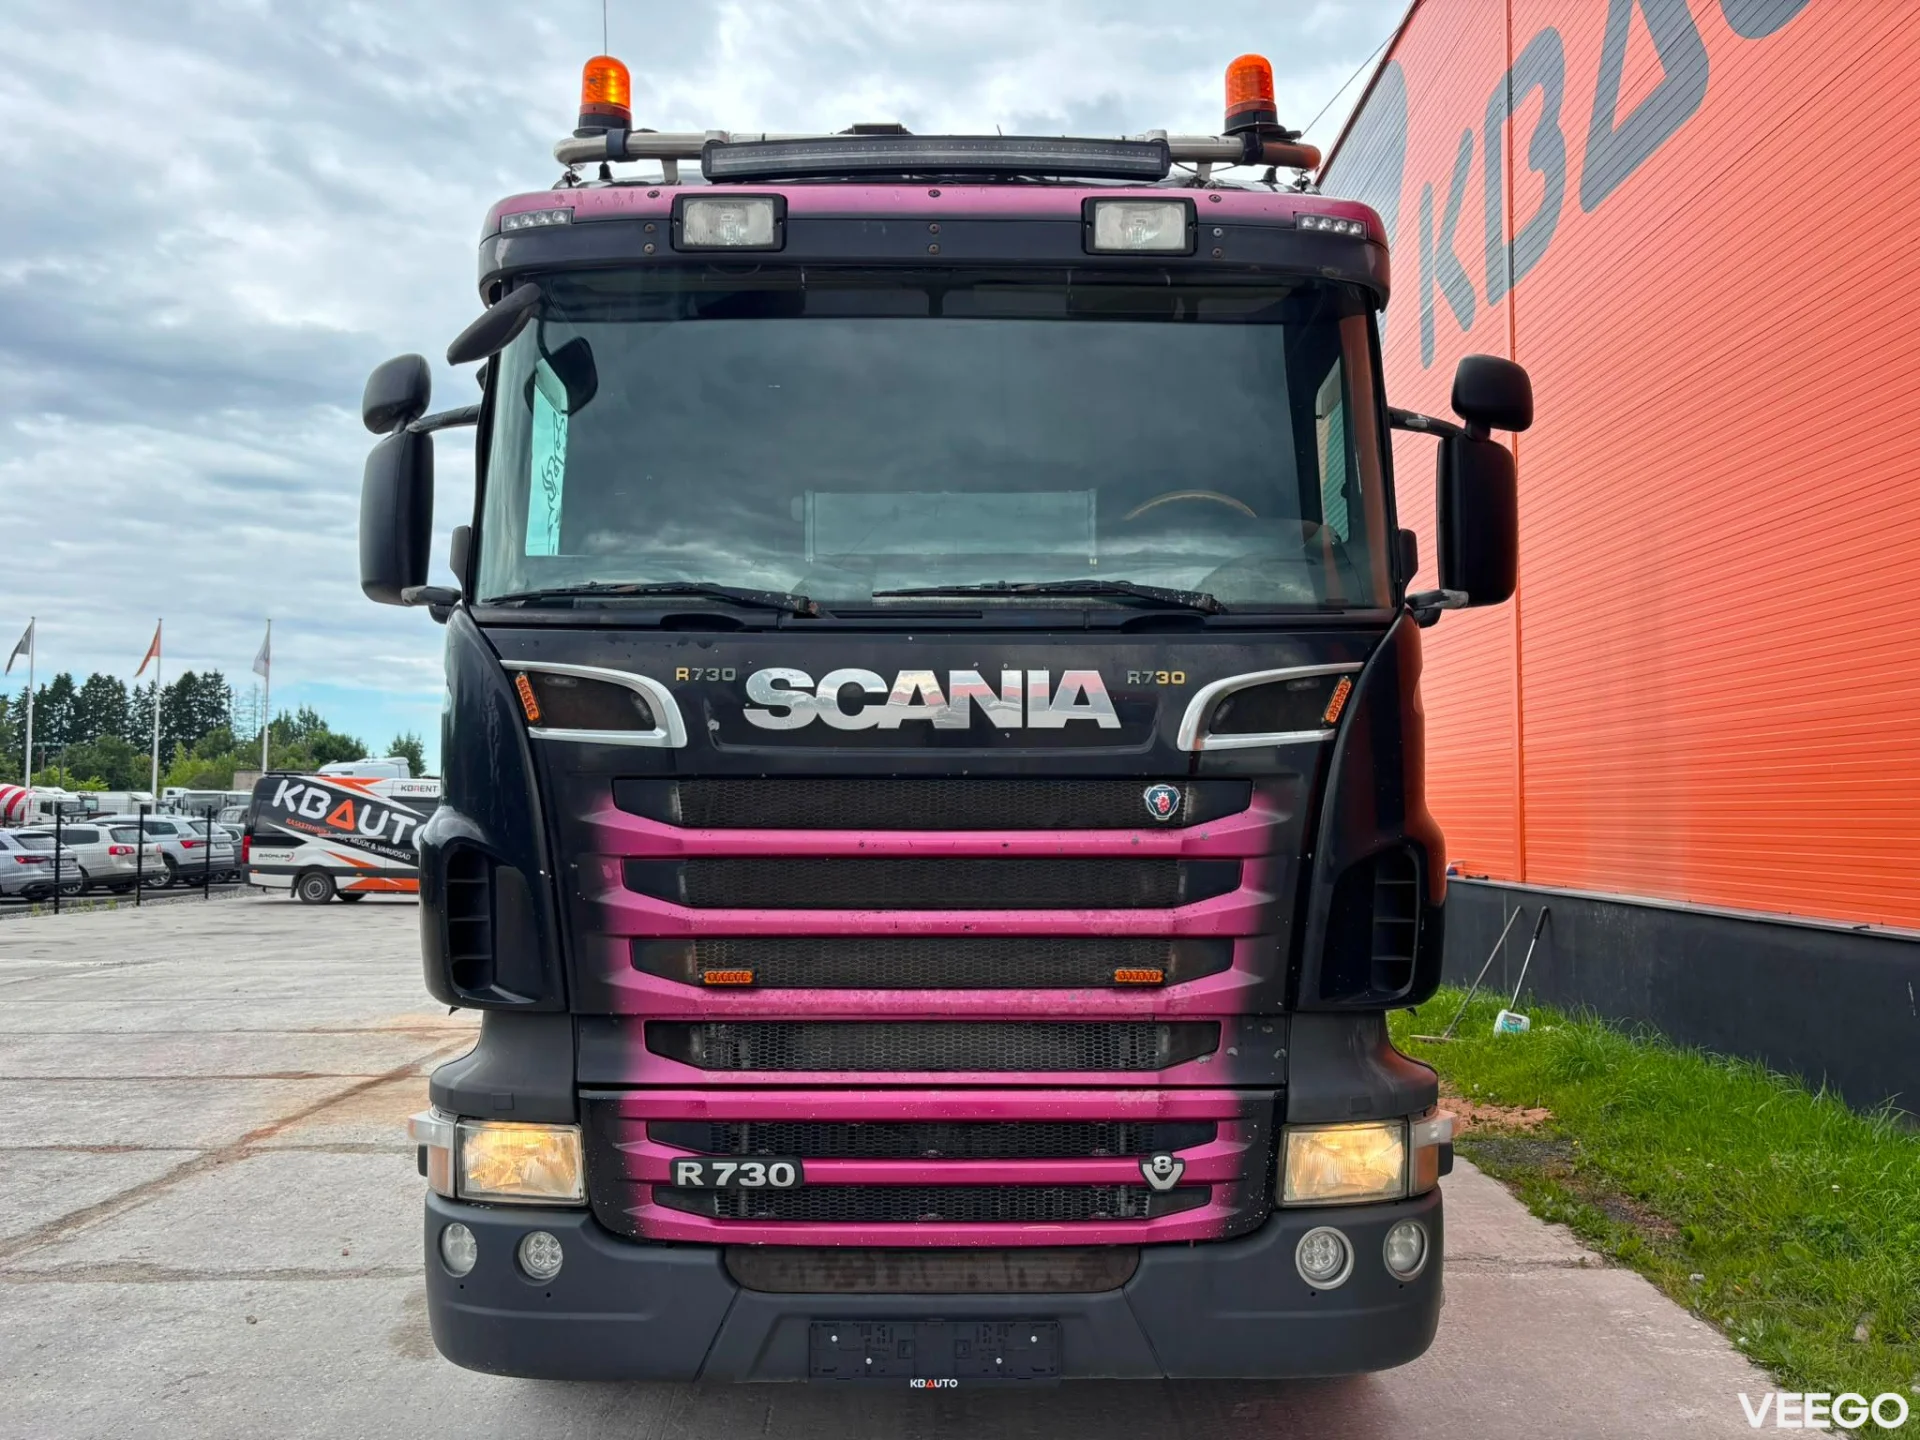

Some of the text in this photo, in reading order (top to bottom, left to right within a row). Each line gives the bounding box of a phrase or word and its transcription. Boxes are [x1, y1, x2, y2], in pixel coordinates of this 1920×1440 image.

[1418, 0, 1806, 370] KBA
[675, 667, 736, 681] R730
[1127, 670, 1185, 684] R730
[743, 667, 1122, 730] SCANIA
[712, 1162, 796, 1187] 730
[910, 1378, 958, 1389] KBAUTO
